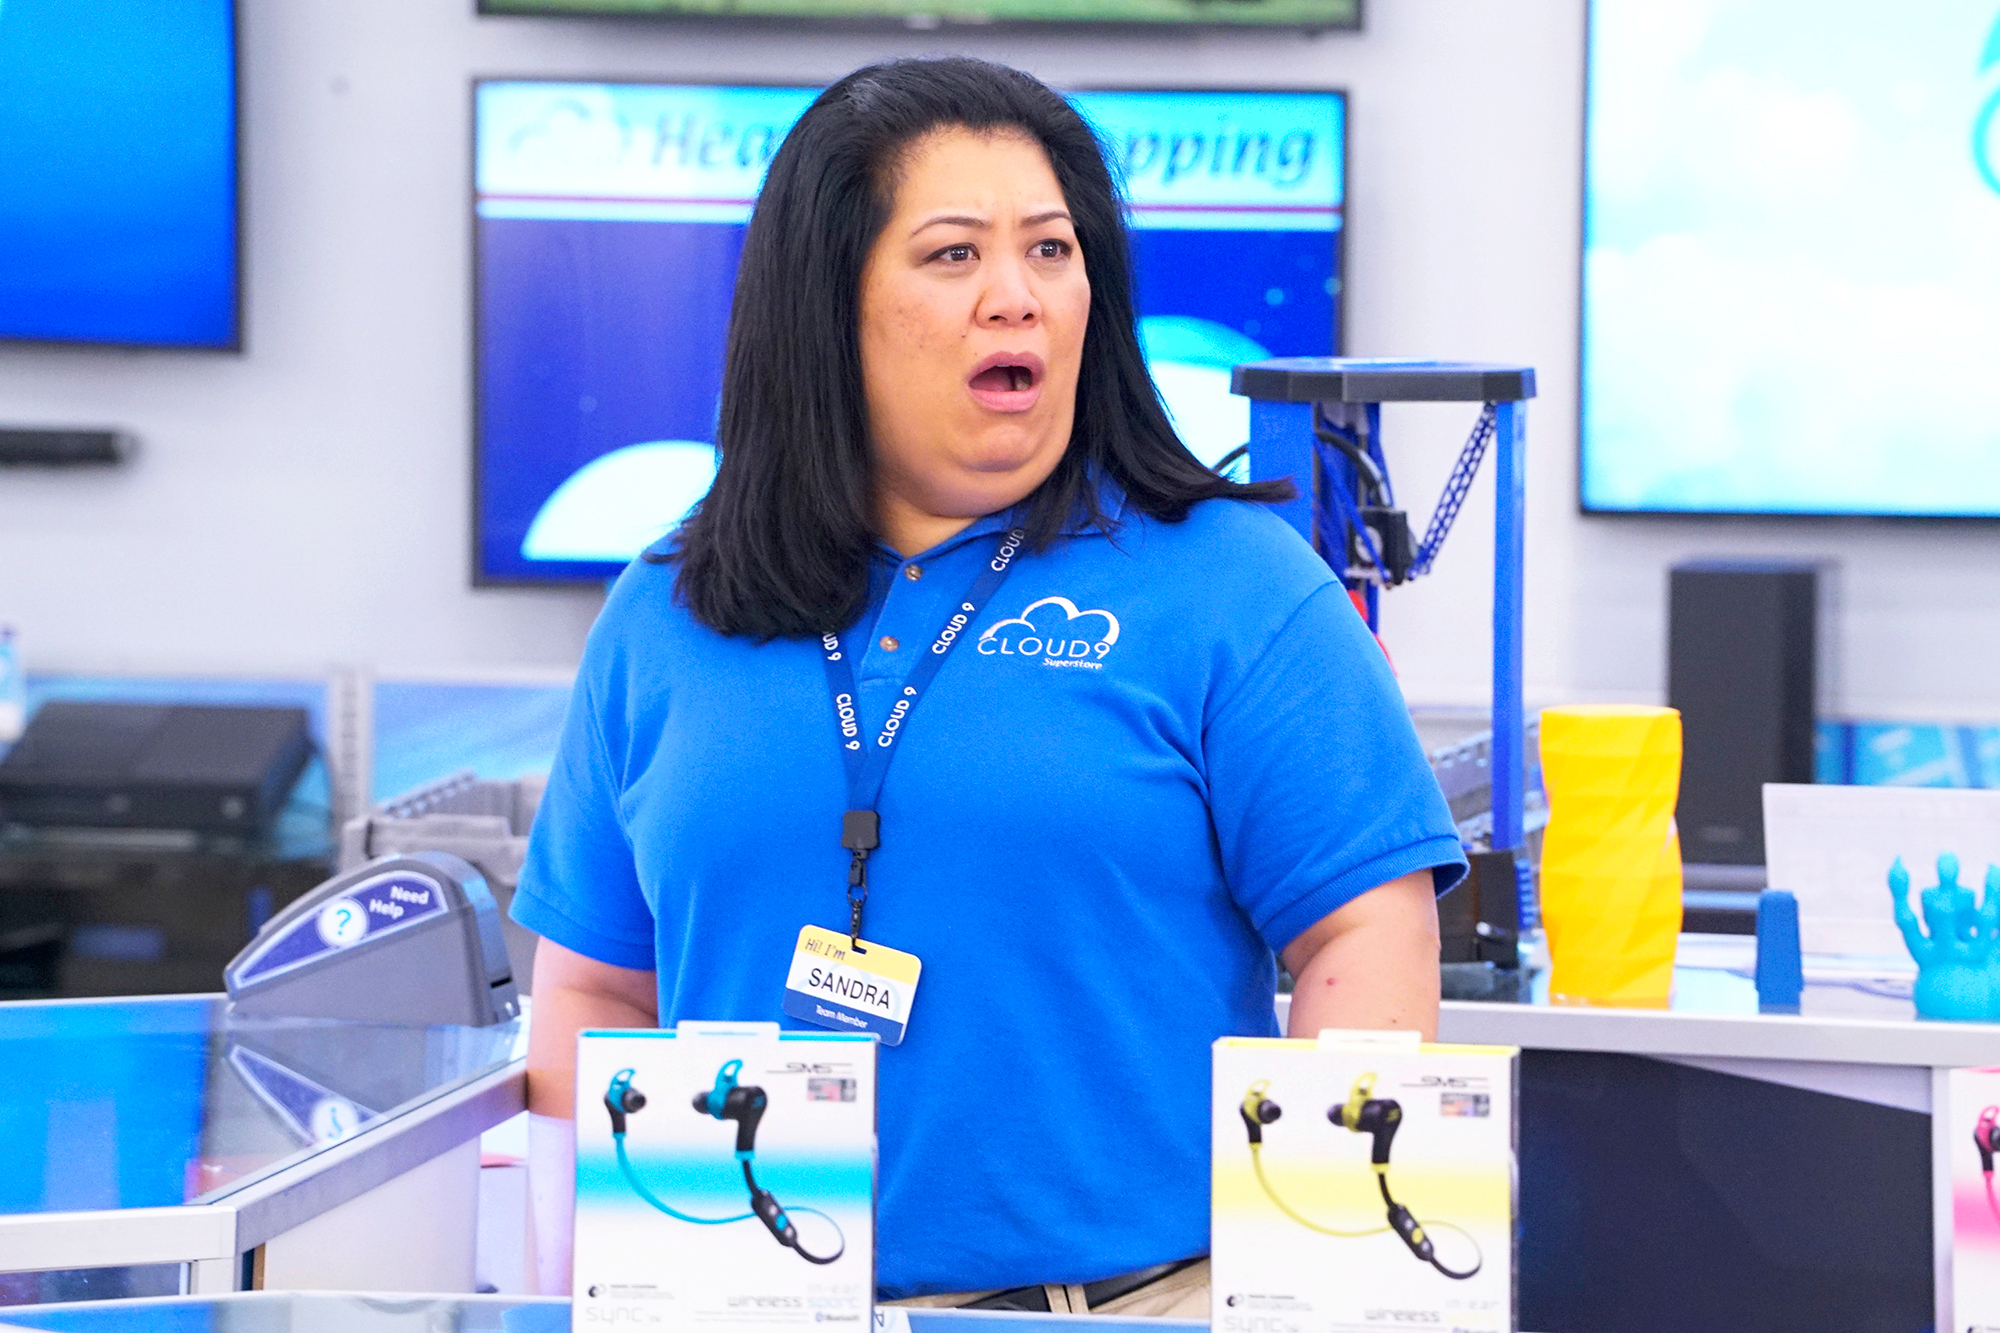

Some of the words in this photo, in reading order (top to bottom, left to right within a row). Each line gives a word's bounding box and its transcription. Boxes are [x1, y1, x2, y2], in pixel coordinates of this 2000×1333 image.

[651, 113, 778, 170] Hea
[1125, 113, 1317, 189] pping
[990, 528, 1025, 572] CLOUD
[931, 613, 968, 655] CLOUD
[961, 602, 976, 613] 9
[827, 652, 842, 661] 9
[976, 636, 1111, 660] CLOUD9
[1043, 657, 1103, 670] Superstore
[835, 693, 858, 738] CLOUD
[878, 699, 909, 748] CLOUD
[903, 687, 917, 697] 9
[845, 740, 861, 751] 9
[390, 885, 430, 905] Need
[369, 898, 405, 920] Help
[336, 908, 352, 936] ?
[805, 938, 823, 954] Hi!
[823, 944, 847, 961] I'm
[808, 967, 891, 1010] SANDRA
[815, 1004, 836, 1019] Team
[836, 1010, 869, 1029] Member
[727, 1295, 803, 1308] wireless
[585, 1306, 643, 1326] sync
[1364, 1308, 1441, 1323] wireless
